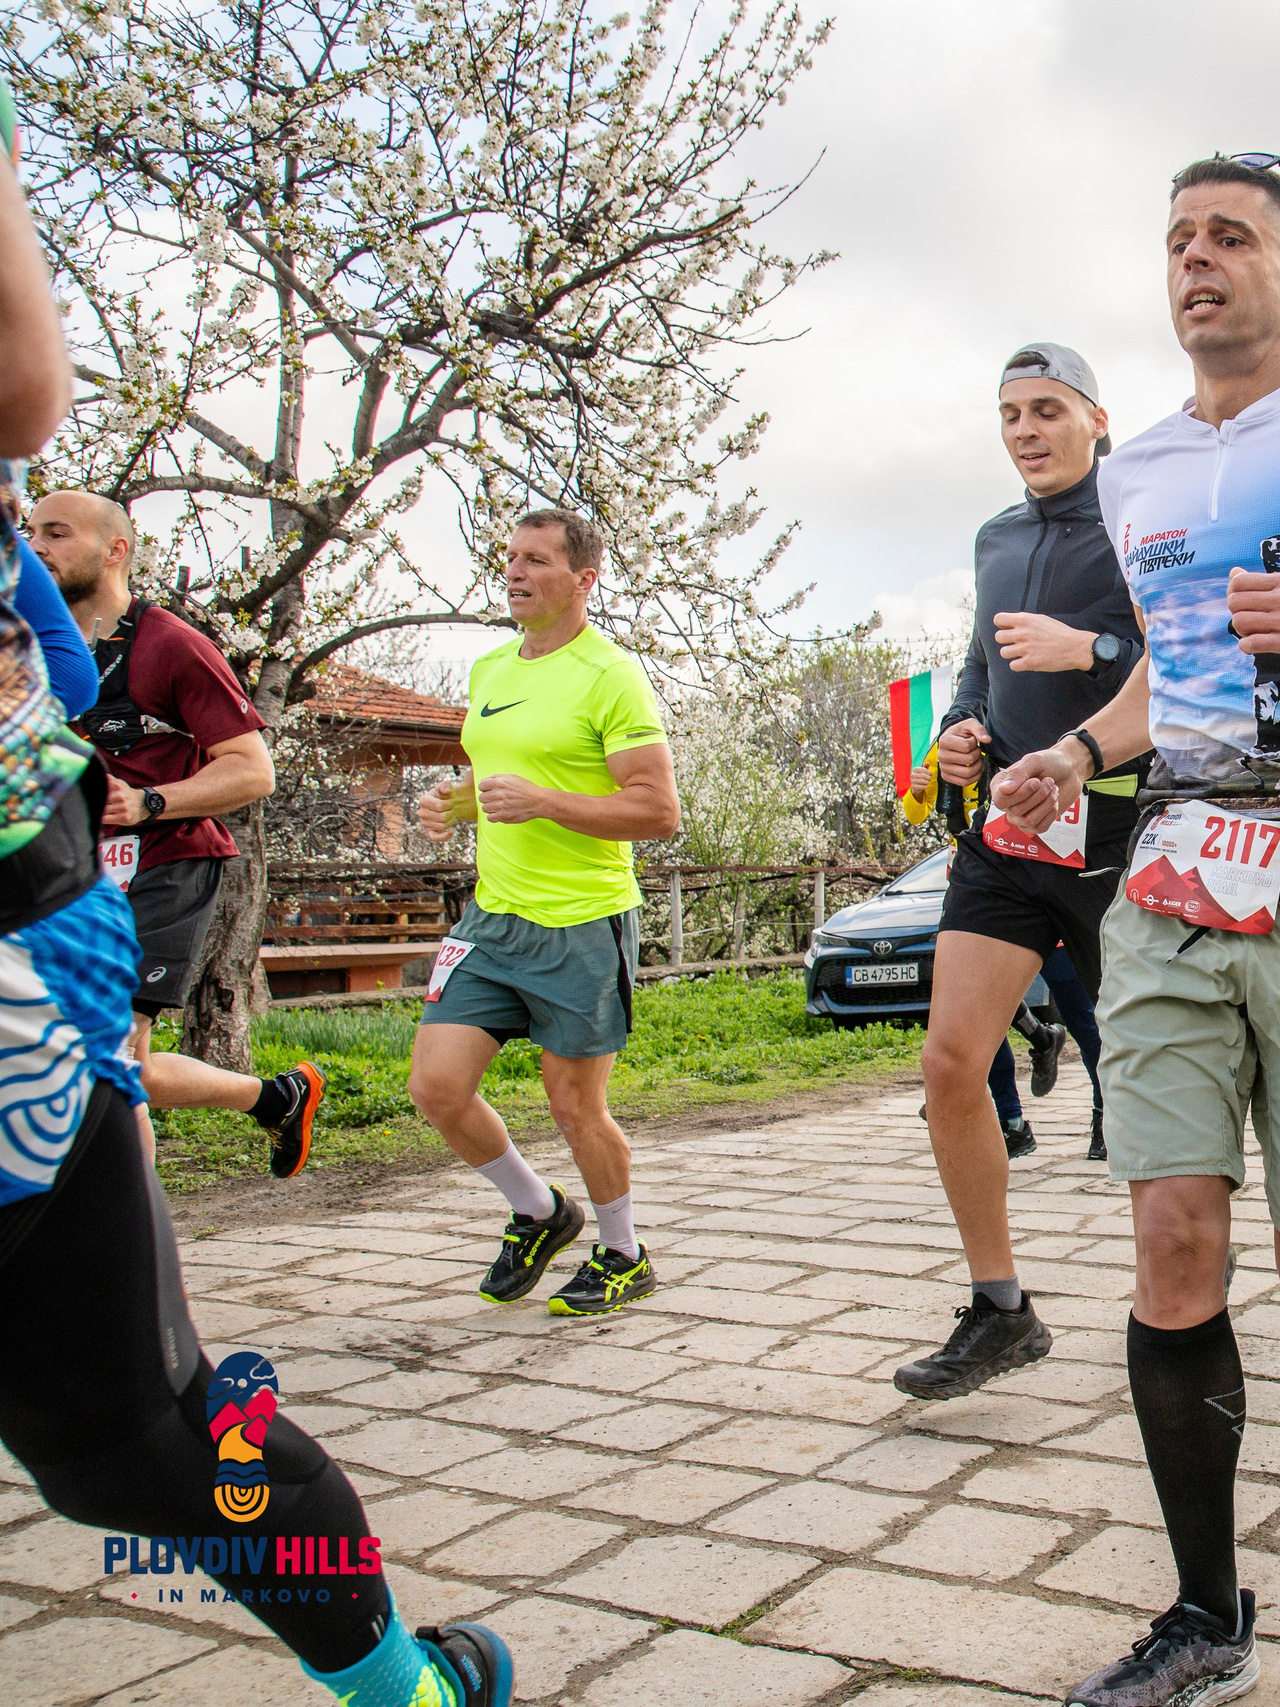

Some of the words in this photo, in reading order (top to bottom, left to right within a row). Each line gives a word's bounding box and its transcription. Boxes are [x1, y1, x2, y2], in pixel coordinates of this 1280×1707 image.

[1140, 528, 1188, 546] МАРАТОН
[1142, 833, 1159, 845] 22K
[98, 843, 134, 867] 46
[1210, 865, 1273, 888] MARKOVO
[1207, 878, 1239, 896] TRAIL
[854, 969, 869, 981] CB
[871, 967, 899, 981] 4795
[900, 966, 916, 980] HC
[529, 1229, 550, 1257] GORE-TEX
